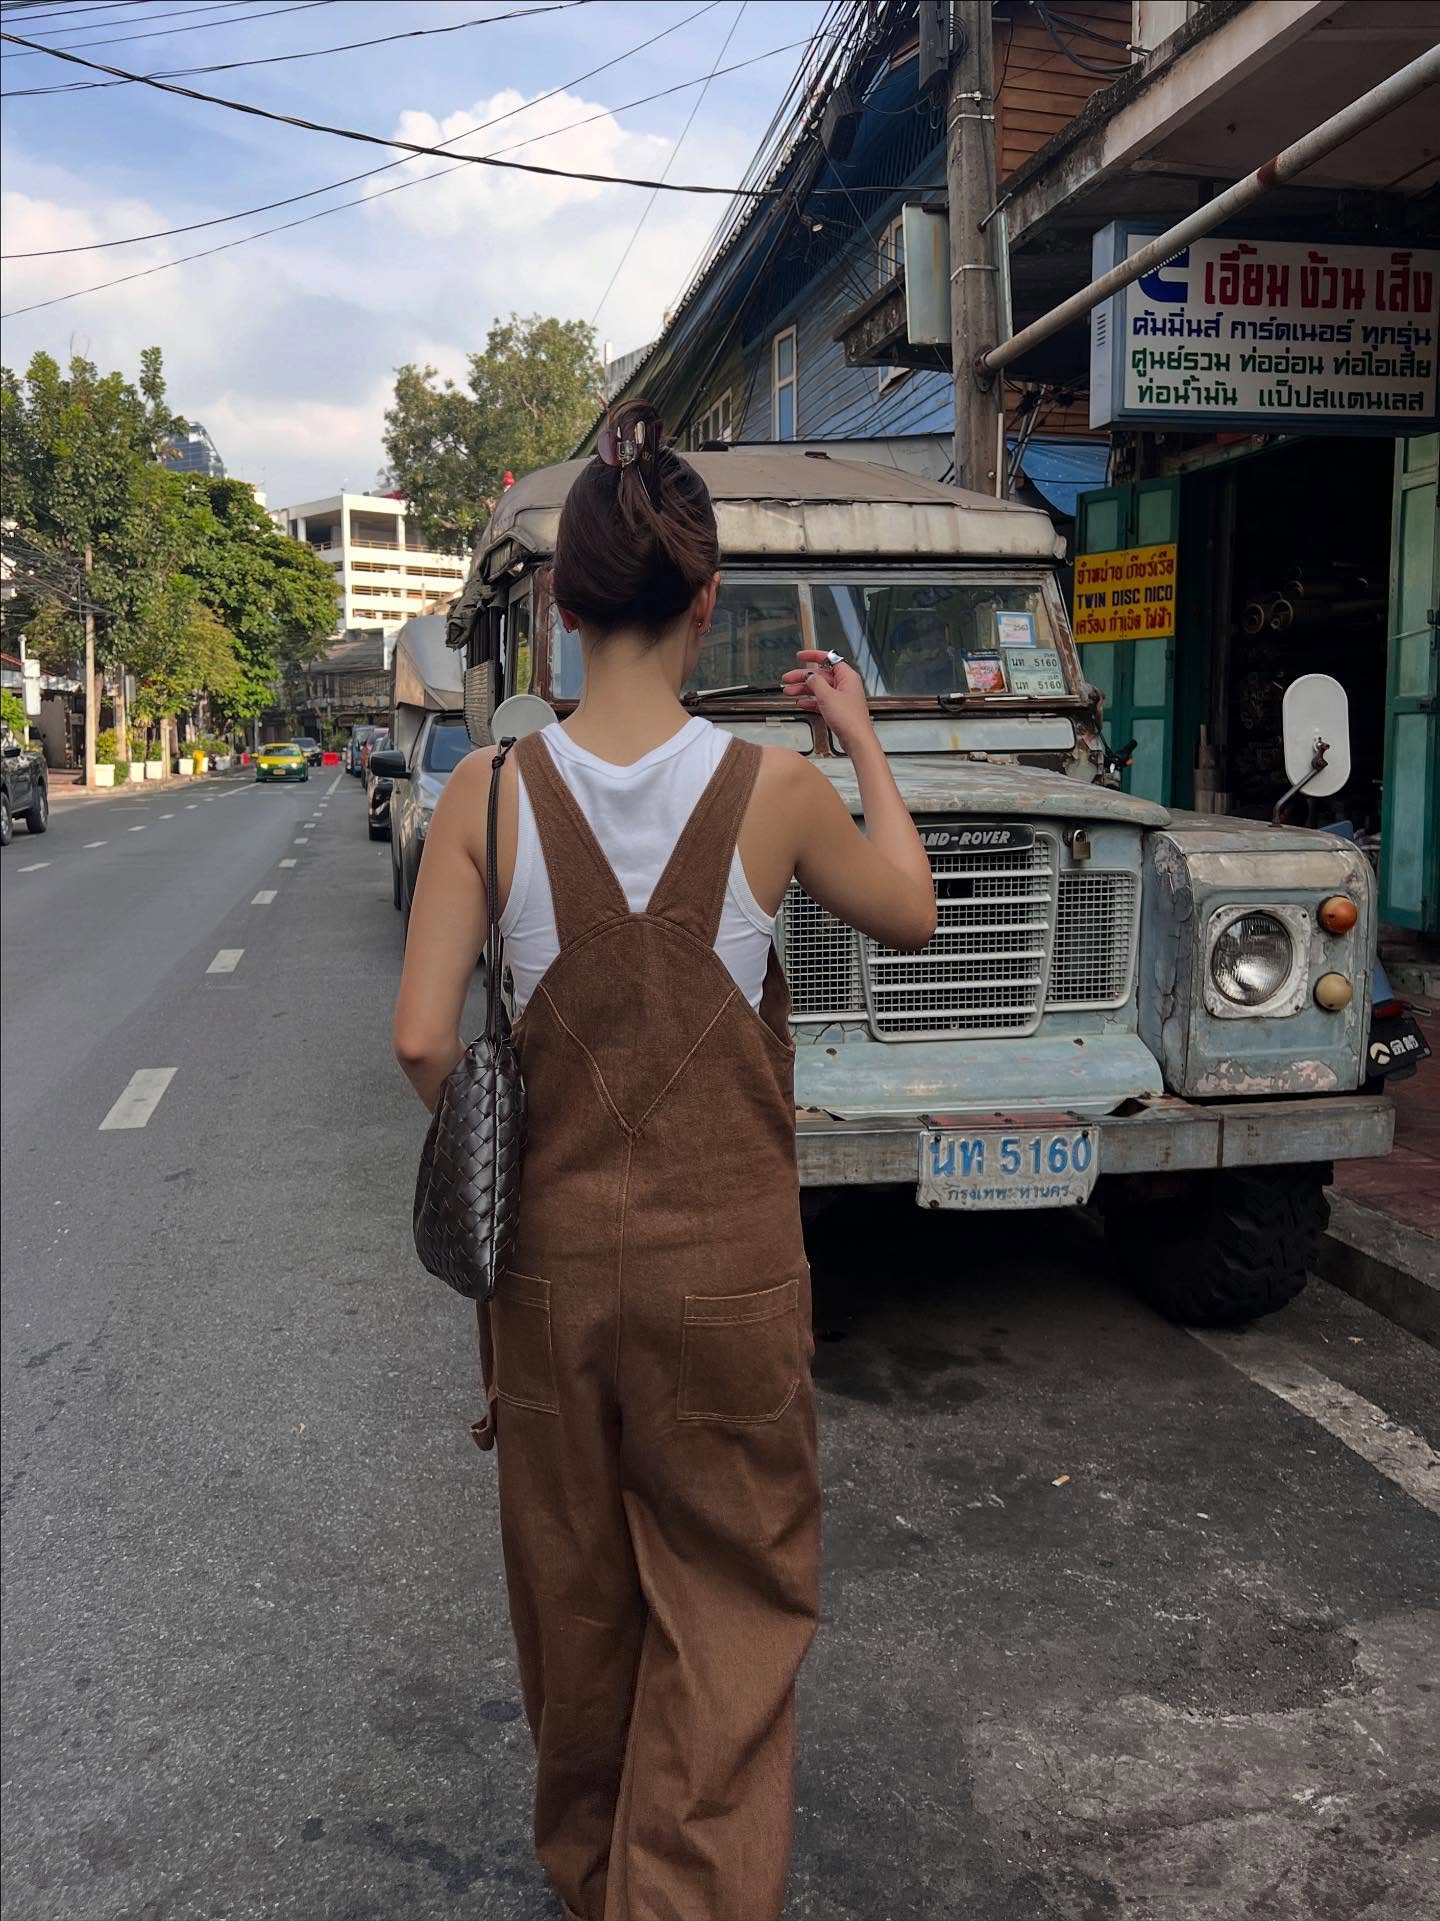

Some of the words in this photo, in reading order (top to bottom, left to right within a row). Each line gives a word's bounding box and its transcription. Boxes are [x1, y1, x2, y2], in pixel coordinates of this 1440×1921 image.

[1205, 243, 1290, 307] เอี้ยม
[1300, 250, 1366, 310] ง้วน
[1375, 251, 1433, 312] เส็ง
[1230, 316, 1355, 343] การ์ดเนอร์
[1361, 320, 1432, 351] ทุกรุ่น
[1131, 345, 1231, 377] ศูนย์รวม
[1239, 346, 1325, 375] ท่ออ่อน
[1333, 350, 1432, 378] ท่อไอเสีย
[1137, 375, 1238, 406] ท่อน้ำมัน
[1076, 560, 1123, 585] จำหน่าย
[1126, 551, 1174, 580] เกียร์เรือ
[1076, 592, 1106, 609] TWIN
[1111, 588, 1140, 607] DISC
[1075, 610, 1106, 635] เครื่อง
[1143, 606, 1172, 630] ไฟฟ้า
[1033, 658, 1058, 667] 5160
[1037, 680, 1062, 690] 5160
[919, 831, 1011, 847] AND-ROVER
[928, 1137, 986, 1178] นท
[999, 1135, 1093, 1176] 5160
